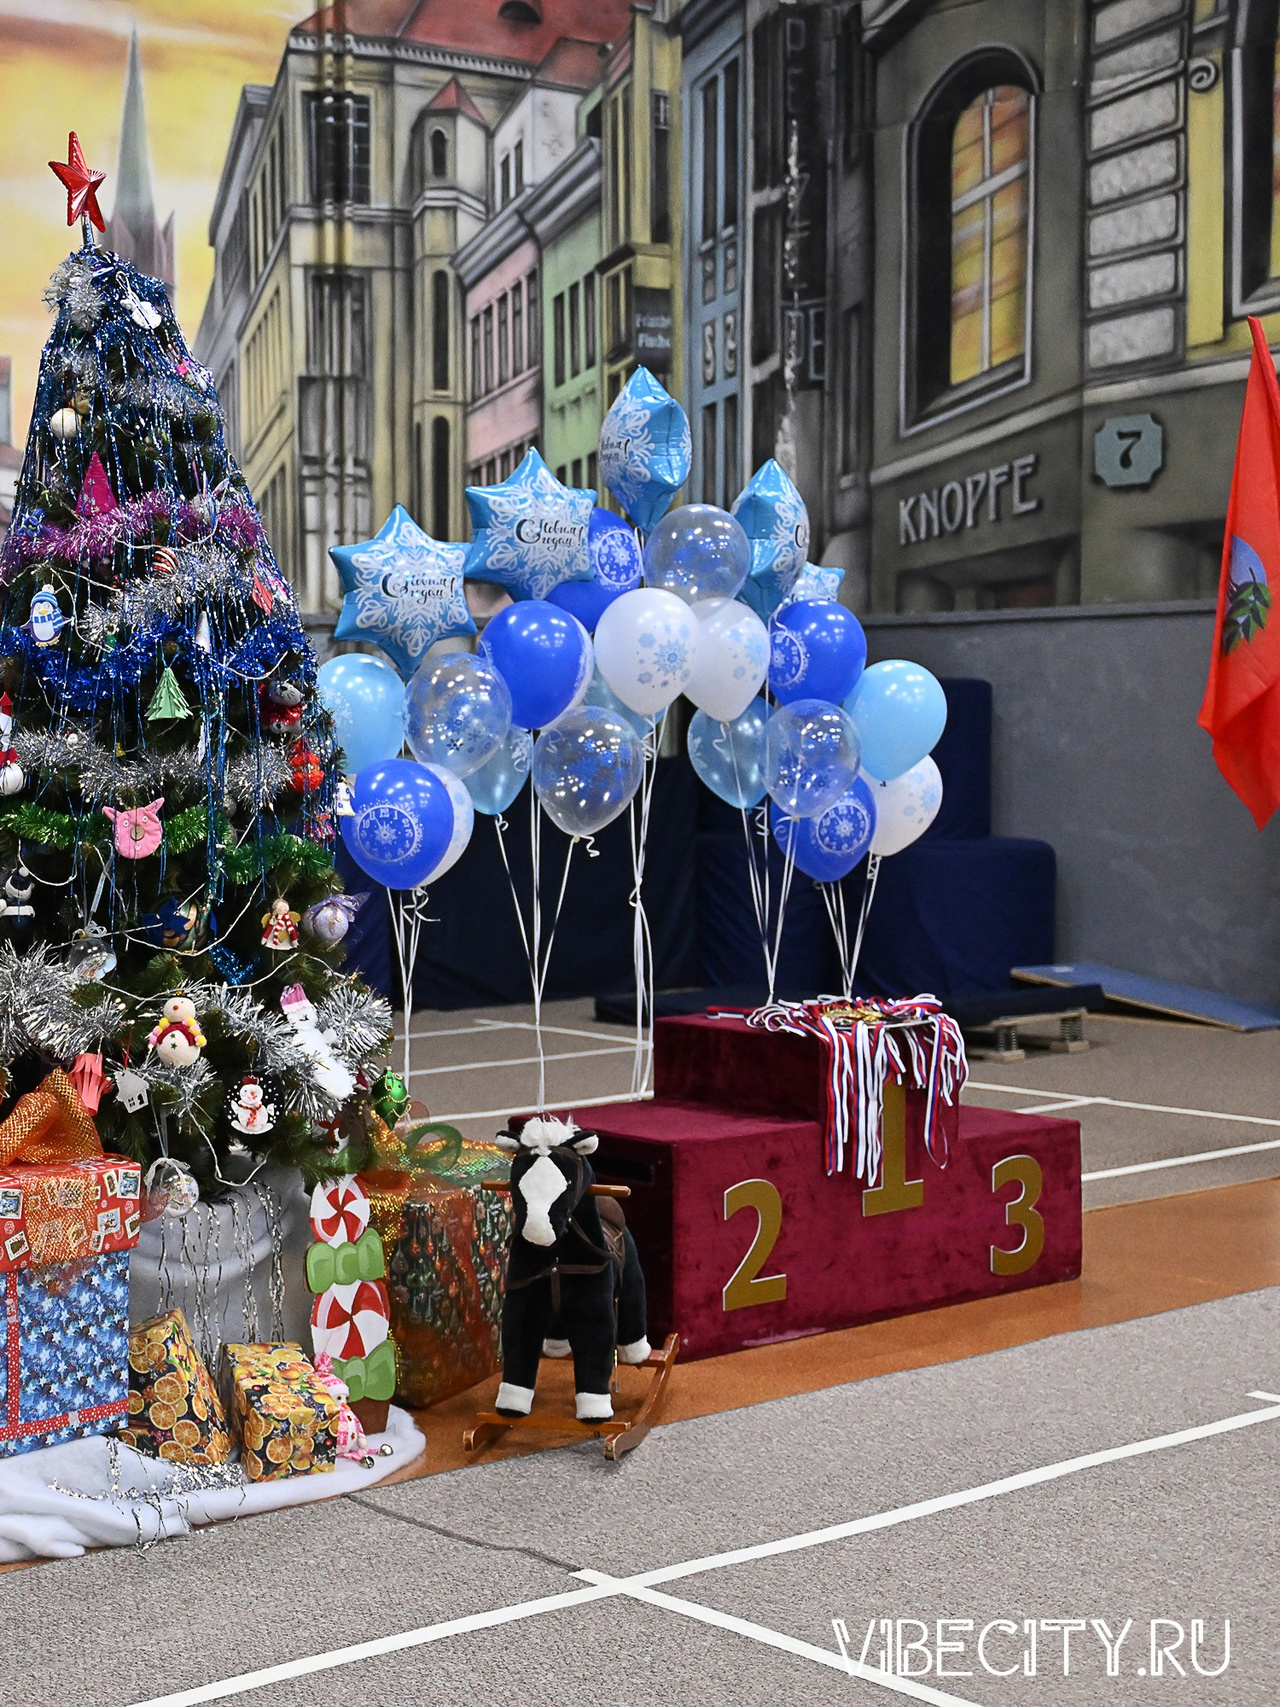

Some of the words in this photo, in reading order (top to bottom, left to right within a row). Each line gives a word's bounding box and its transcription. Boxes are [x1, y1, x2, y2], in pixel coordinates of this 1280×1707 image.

[898, 453, 1040, 546] KNOPFE
[1115, 429, 1144, 470] 7
[863, 1080, 924, 1217] 1
[723, 1178, 787, 1312] 2
[990, 1154, 1045, 1277] 3
